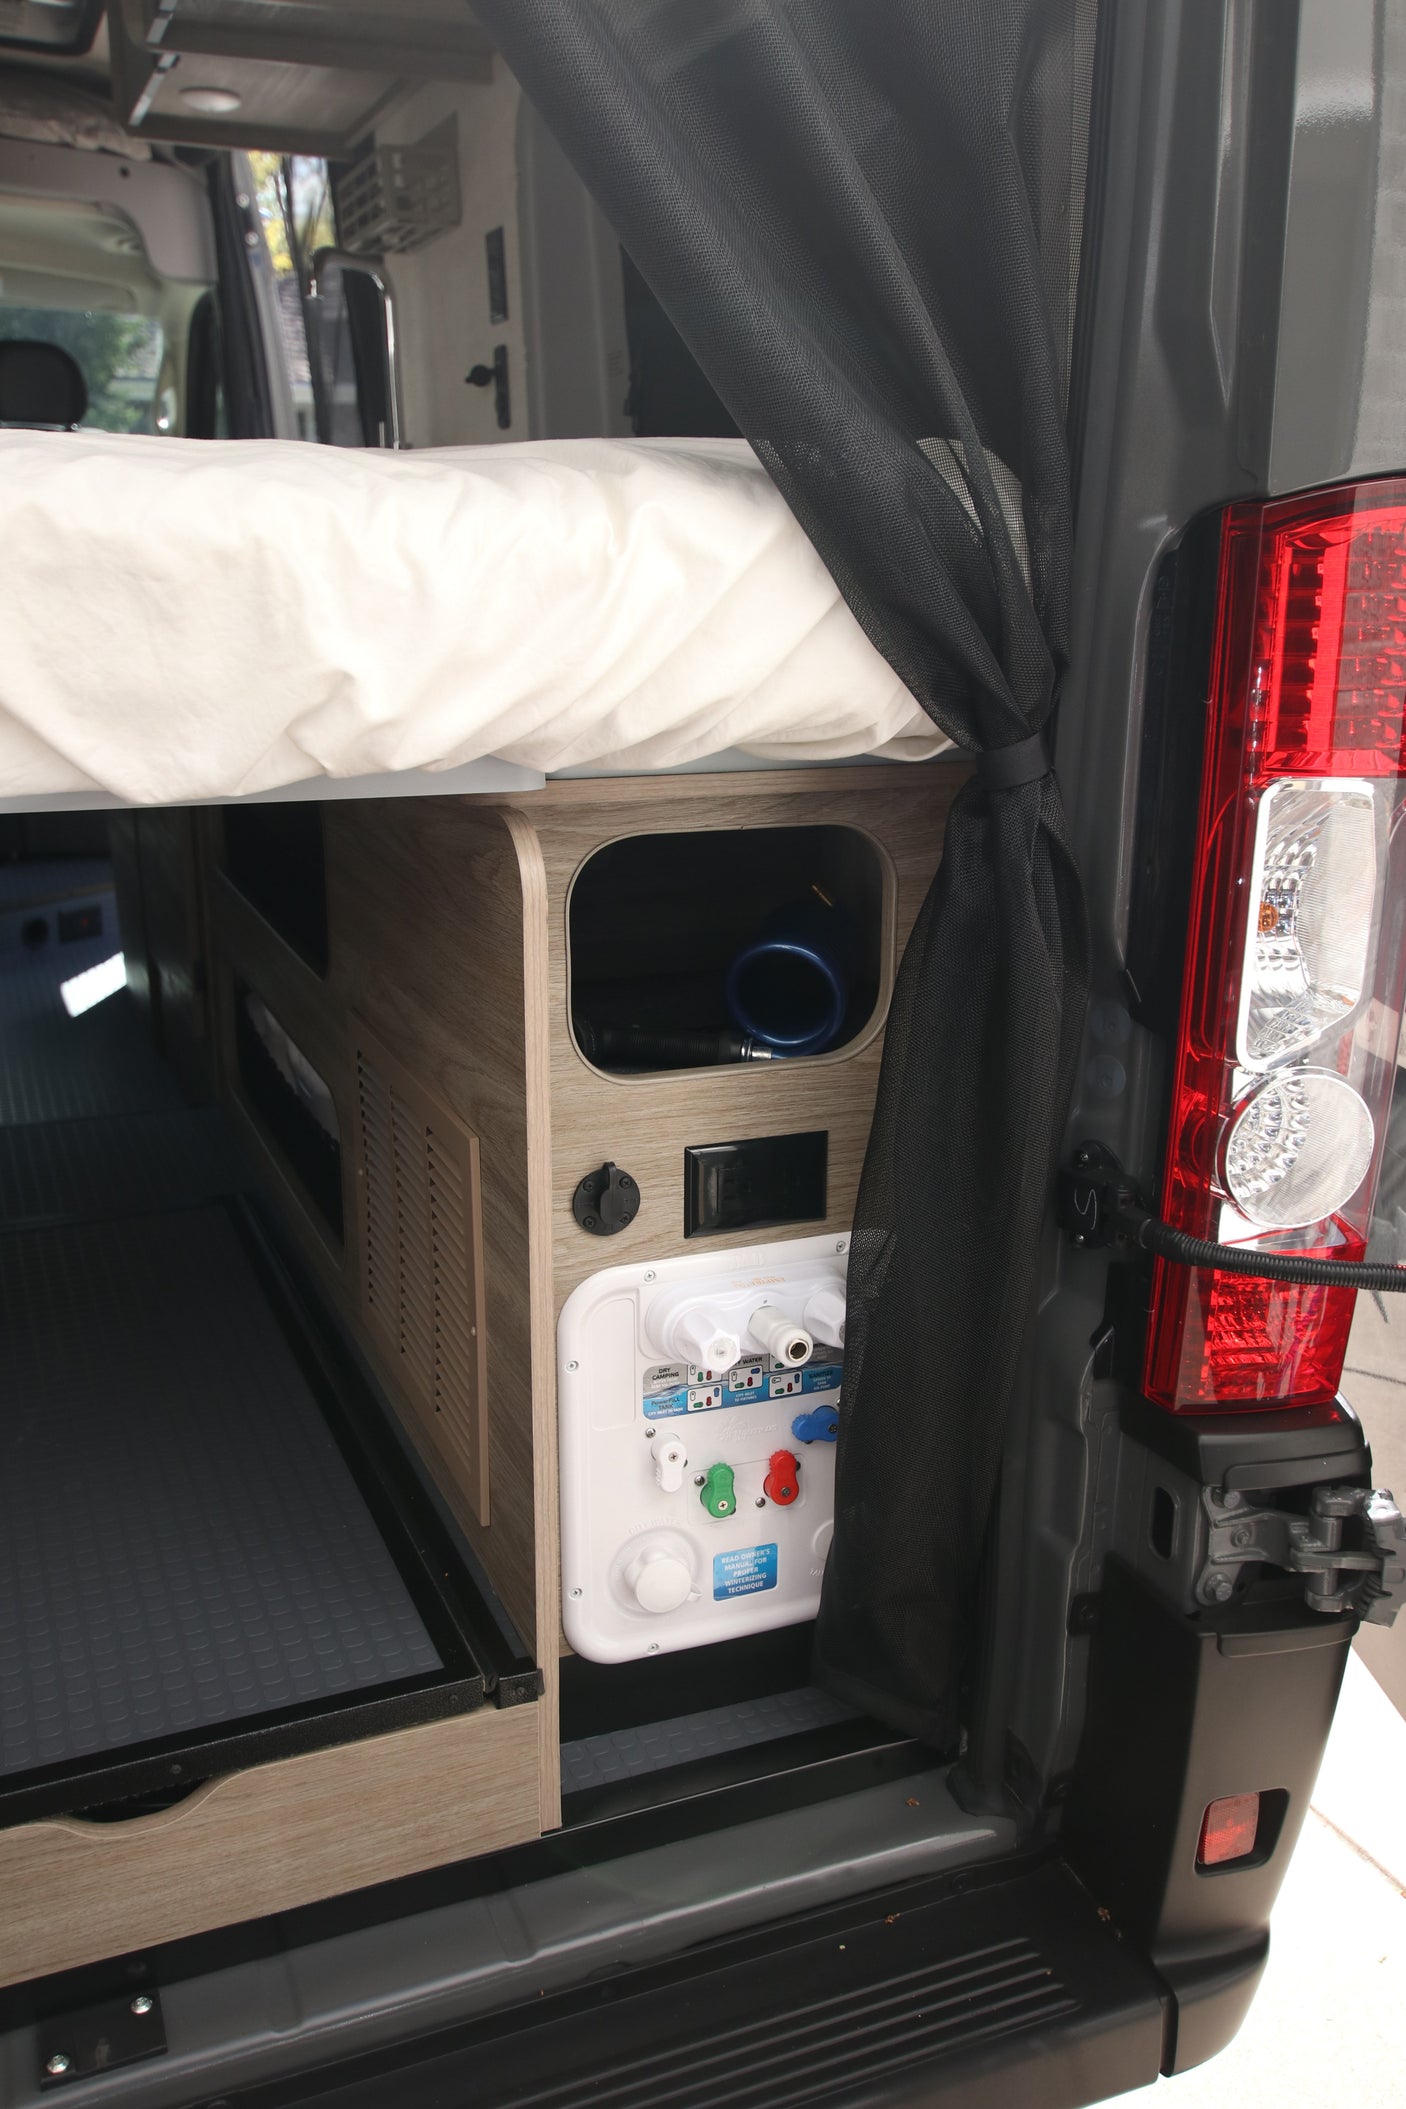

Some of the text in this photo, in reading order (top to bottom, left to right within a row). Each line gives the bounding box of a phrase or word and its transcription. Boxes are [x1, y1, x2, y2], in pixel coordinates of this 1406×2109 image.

[652, 1371, 679, 1380] CAMPING
[721, 1548, 771, 1564] READ OWNER'S
[725, 1561, 754, 1571] MANUAL
[733, 1566, 758, 1577] PROPER
[725, 1572, 767, 1587] WINTERIZING
[728, 1581, 764, 1594] TECHNIQUE
